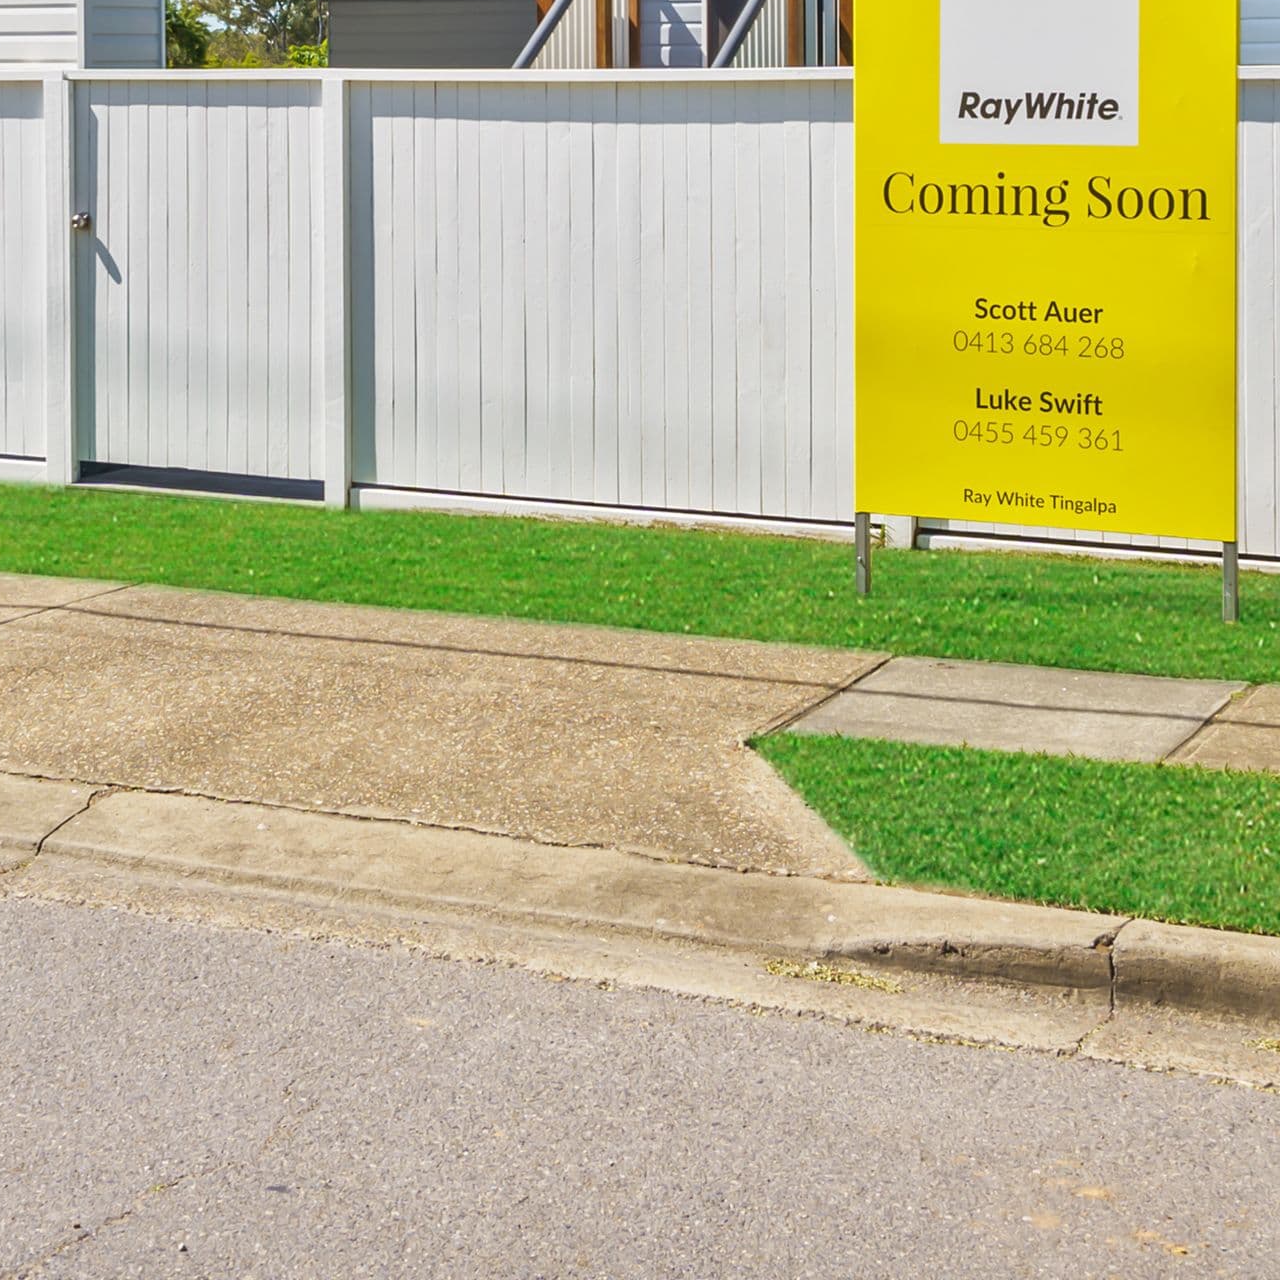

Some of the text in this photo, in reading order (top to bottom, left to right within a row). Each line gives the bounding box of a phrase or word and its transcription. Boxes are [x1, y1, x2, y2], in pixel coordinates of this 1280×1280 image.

[883, 171, 1211, 228] Coming Soon
[974, 297, 1104, 324] Scott Auer
[953, 330, 1125, 360] 0413 684 268
[975, 387, 1103, 416] Luke Swift
[953, 420, 1124, 452] 0455 459 361
[963, 488, 1117, 516] Ray White Tingalpa
